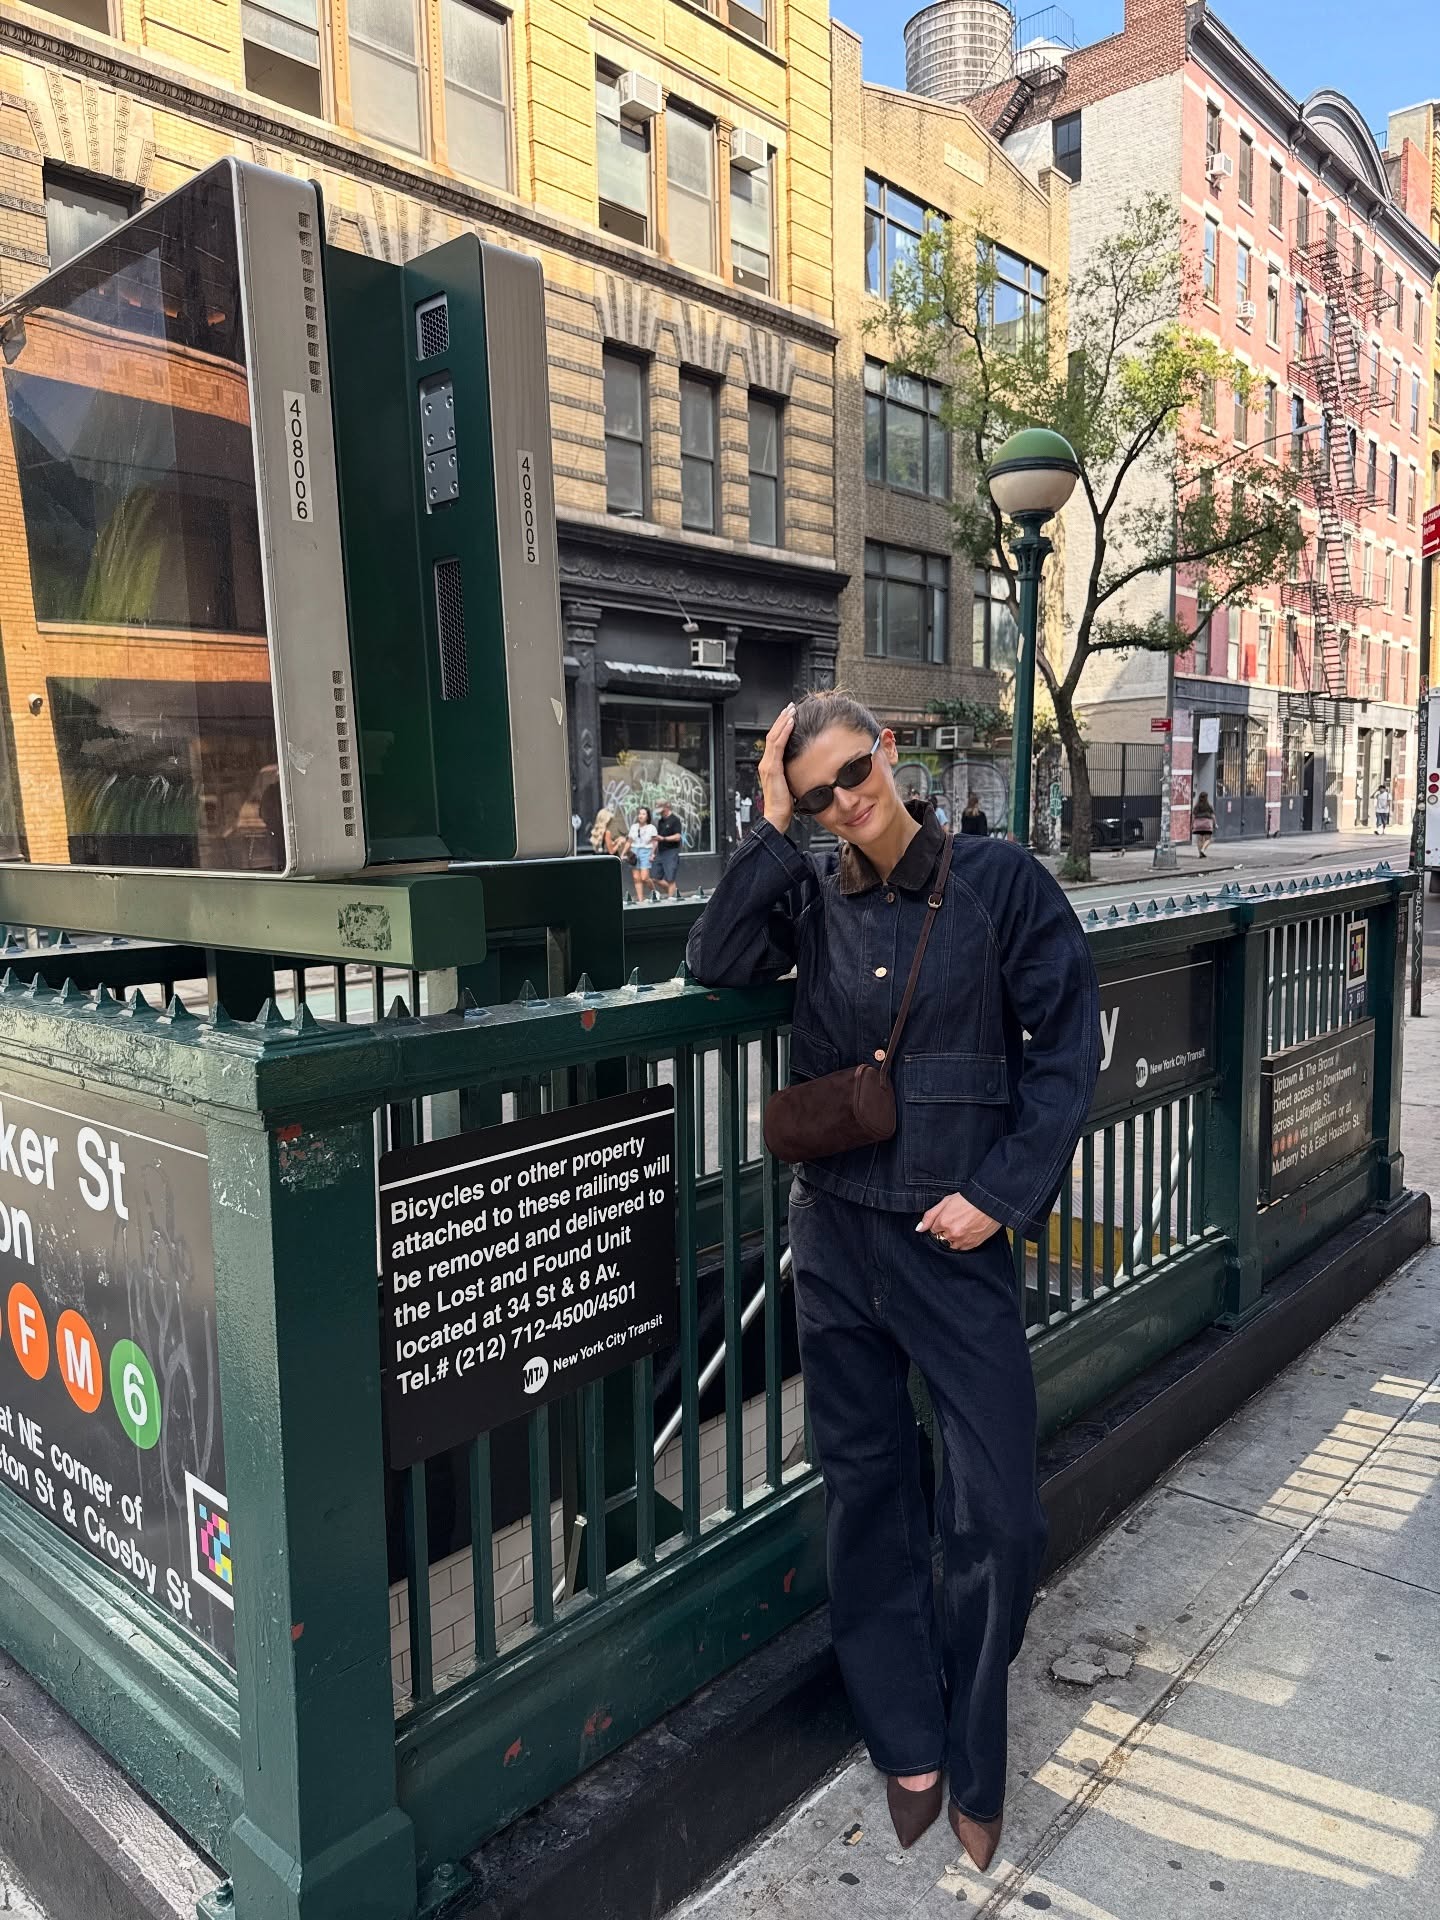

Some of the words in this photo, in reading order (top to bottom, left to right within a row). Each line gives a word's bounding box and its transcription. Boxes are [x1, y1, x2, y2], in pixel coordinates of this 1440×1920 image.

[290, 399, 308, 519] 408006
[522, 456, 536, 562] 408005
[1150, 1064, 1162, 1075] New
[1163, 1058, 1176, 1071] York
[1176, 1054, 1186, 1067] City
[1187, 1047, 1206, 1062] Transit
[1273, 1072, 1298, 1095] Uptown
[1305, 1063, 1317, 1078] The
[1318, 1056, 1334, 1072] Bronx
[1273, 1093, 1292, 1114] Direct
[1293, 1084, 1315, 1104] access
[1315, 1079, 1323, 1092] to
[1323, 1065, 1352, 1089] Downtown
[1272, 1151, 1299, 1177] Mulberry
[1300, 1143, 1308, 1159] St
[1315, 1131, 1328, 1150] East
[1328, 1120, 1352, 1142] Houston
[1273, 1114, 1294, 1135] across
[1295, 1098, 1322, 1123] Lafayette
[1300, 1124, 1308, 1140] via
[1313, 1110, 1337, 1135] platform
[1338, 1106, 1345, 1118] or
[1345, 1099, 1352, 1113] at
[78, 1126, 129, 1220] St
[391, 1182, 484, 1225] Bicycles
[490, 1173, 511, 1194] or
[517, 1156, 567, 1186] other
[573, 1135, 645, 1176] property
[391, 1211, 487, 1259] attached
[493, 1207, 513, 1227] to
[518, 1188, 570, 1219] these
[576, 1165, 639, 1199] railings
[644, 1153, 670, 1180] will
[393, 1270, 421, 1294] be
[428, 1233, 519, 1282] removed
[525, 1223, 561, 1248] and
[566, 1196, 644, 1234] delivered
[649, 1188, 664, 1207] to
[394, 1298, 430, 1328] the
[437, 1280, 485, 1312] Lost
[490, 1261, 527, 1293] and
[533, 1238, 591, 1273] Found
[597, 1225, 632, 1254] Unit
[396, 1312, 476, 1363] located
[483, 1305, 502, 1329] at
[507, 1295, 530, 1319] 34
[536, 1282, 556, 1308] St
[561, 1278, 574, 1297] &
[579, 1270, 590, 1289] 8
[594, 1260, 620, 1285] Av.
[396, 1356, 449, 1395] Tel.#
[455, 1334, 506, 1377] (212)
[511, 1281, 636, 1349] 712-4500/4501
[523, 1360, 546, 1391] MTA
[553, 1353, 578, 1373] New
[579, 1340, 605, 1361] York
[605, 1331, 627, 1349] City
[627, 1314, 663, 1339] Transit
[18, 1302, 36, 1355] F
[64, 1327, 95, 1396] M
[123, 1362, 148, 1426] 6
[18, 1411, 45, 1459] NE
[51, 1444, 113, 1507] corner
[121, 1494, 143, 1531] of
[35, 1467, 56, 1511] St
[63, 1488, 78, 1528] &
[84, 1505, 157, 1595] Crosby
[166, 1567, 193, 1619] St
